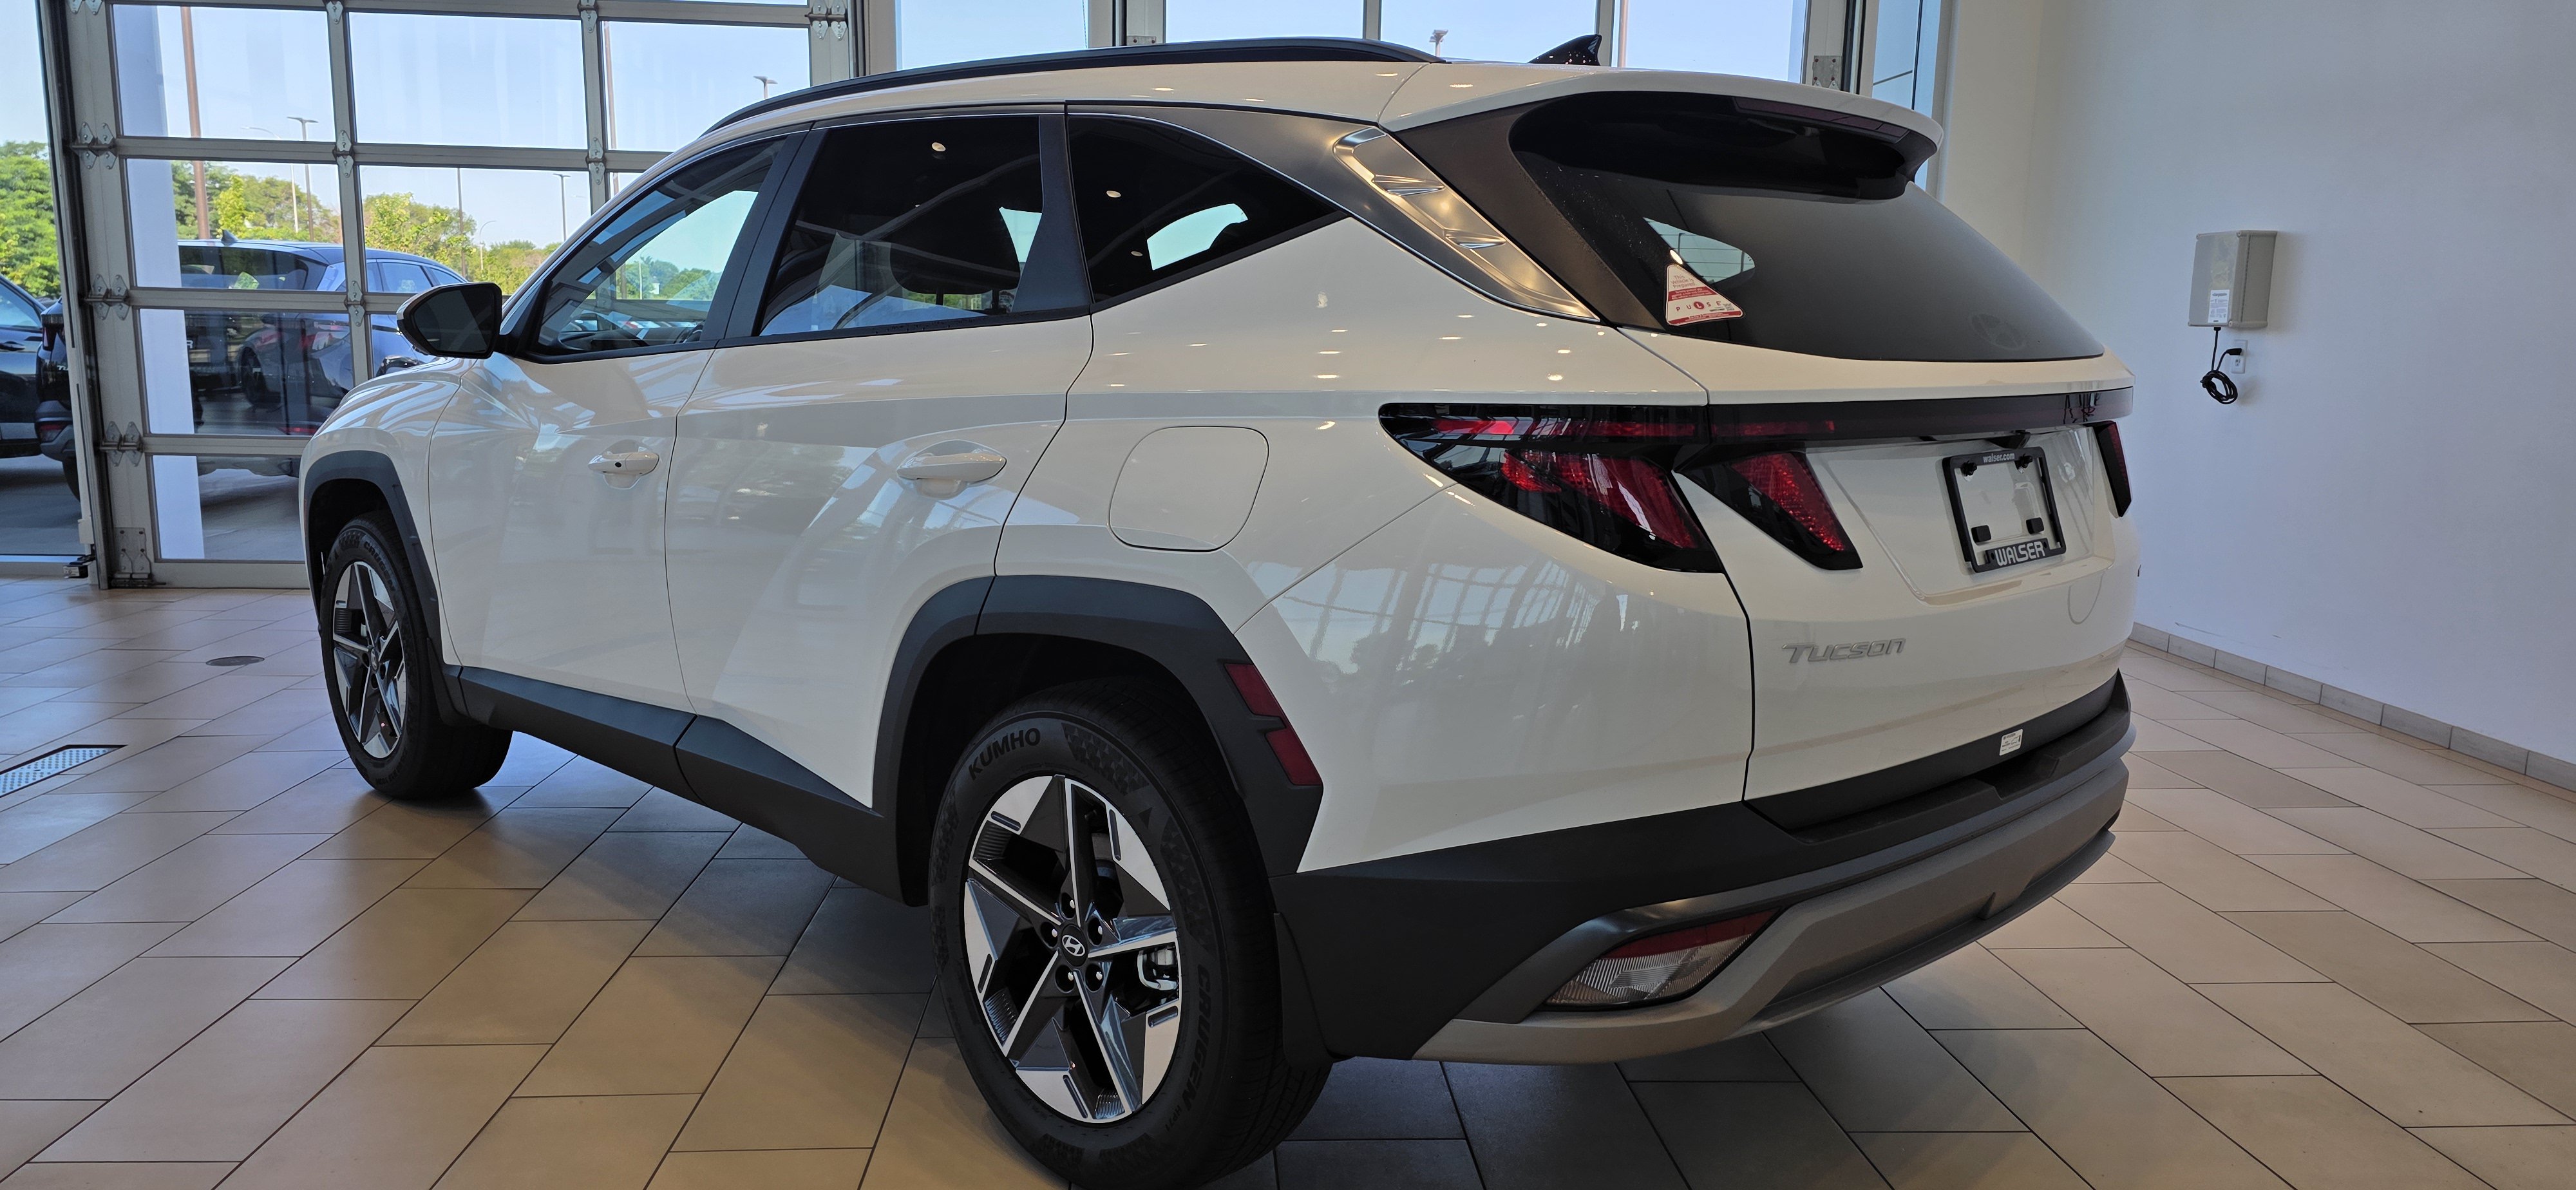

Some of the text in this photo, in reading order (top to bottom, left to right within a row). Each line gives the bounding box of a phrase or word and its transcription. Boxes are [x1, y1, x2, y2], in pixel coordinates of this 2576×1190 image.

[1676, 301, 1721, 312] PULSE
[1983, 453, 2015, 463] walser.com
[1994, 541, 2045, 566] WALSER
[968, 728, 1041, 780] KUMHO
[1165, 963, 1211, 1132] CRUGEN HP71
